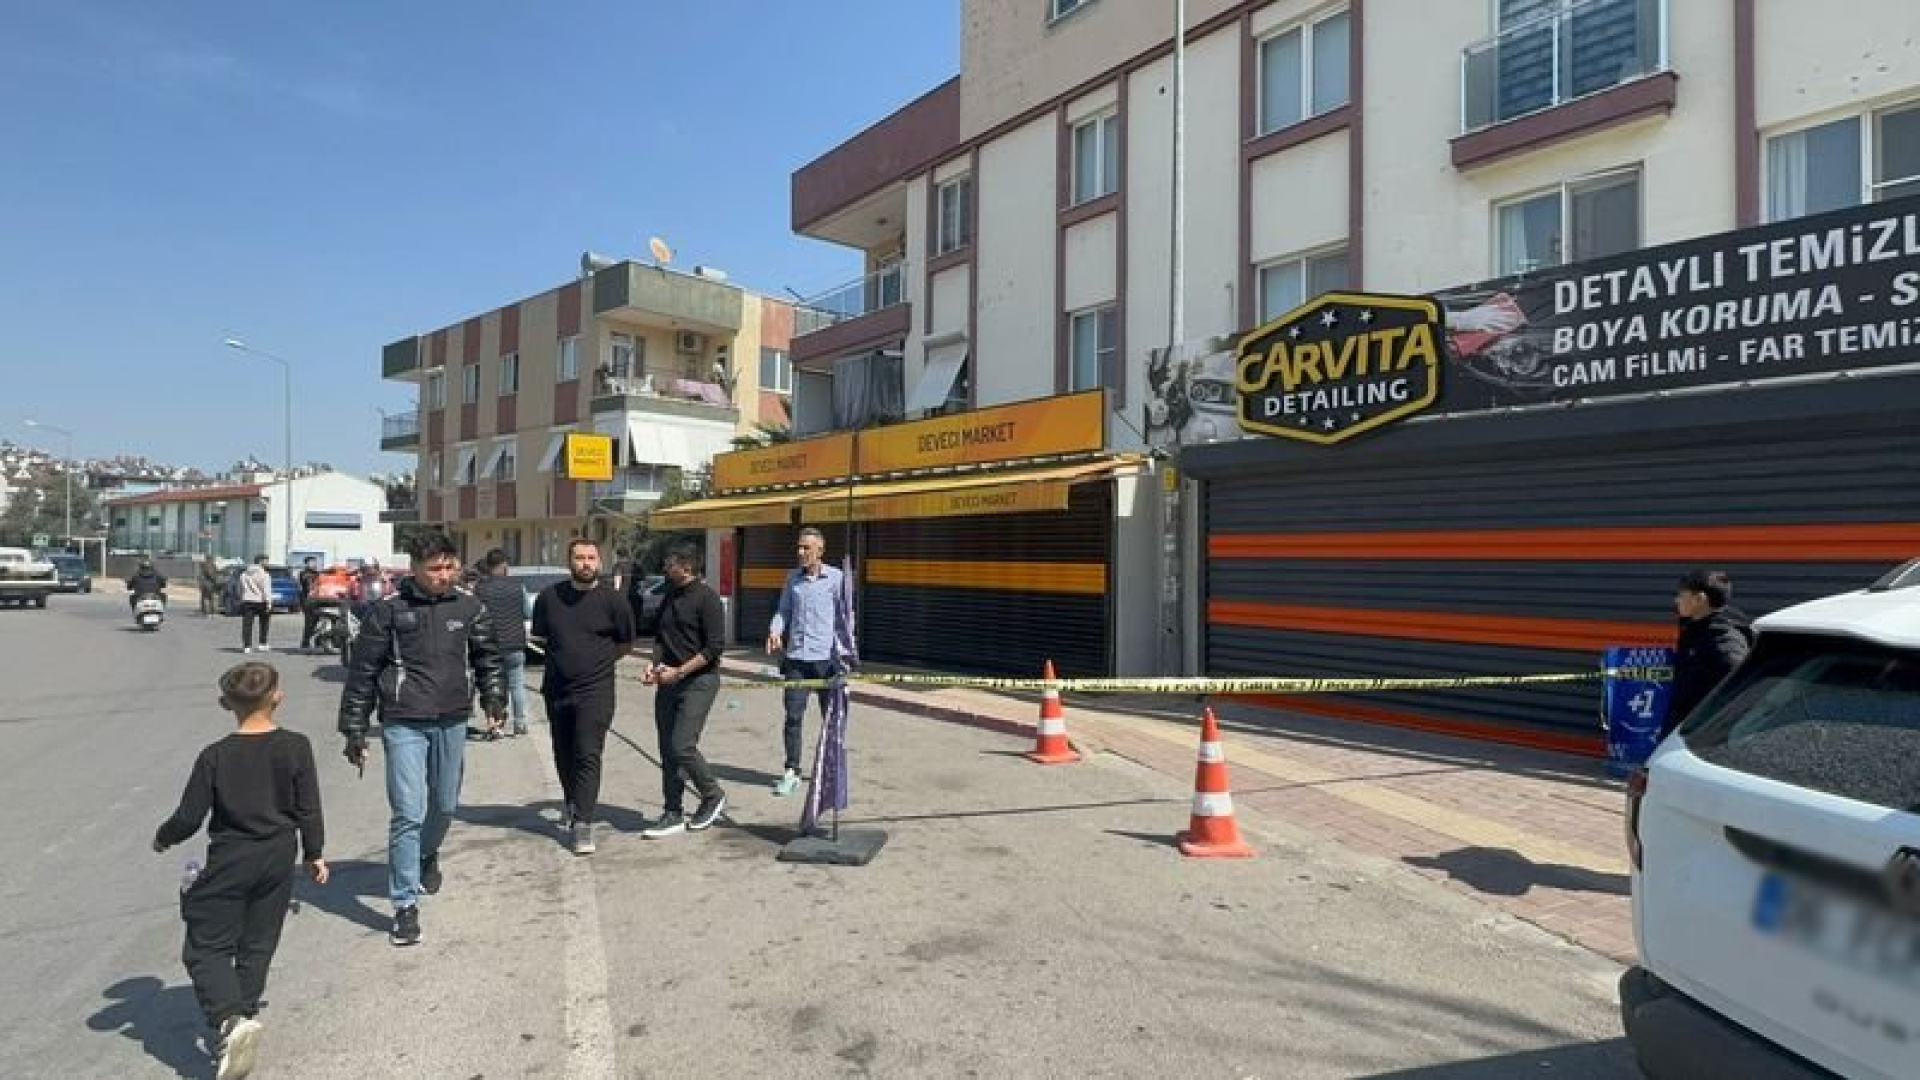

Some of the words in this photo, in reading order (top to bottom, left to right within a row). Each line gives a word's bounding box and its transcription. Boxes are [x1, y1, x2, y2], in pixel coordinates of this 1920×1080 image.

[1554, 251, 1724, 315] DETAYLI
[1553, 314, 1648, 354] BOYA
[1659, 284, 1844, 339] KORUMA
[1553, 357, 1616, 387] CAM
[1624, 345, 1707, 379] FiLMi
[1739, 333, 1806, 366] FAR
[1814, 317, 1920, 356] TEMi
[1236, 323, 1437, 393] CARVITA
[1264, 378, 1408, 417] DETAILING
[962, 422, 1016, 446] MARKET
